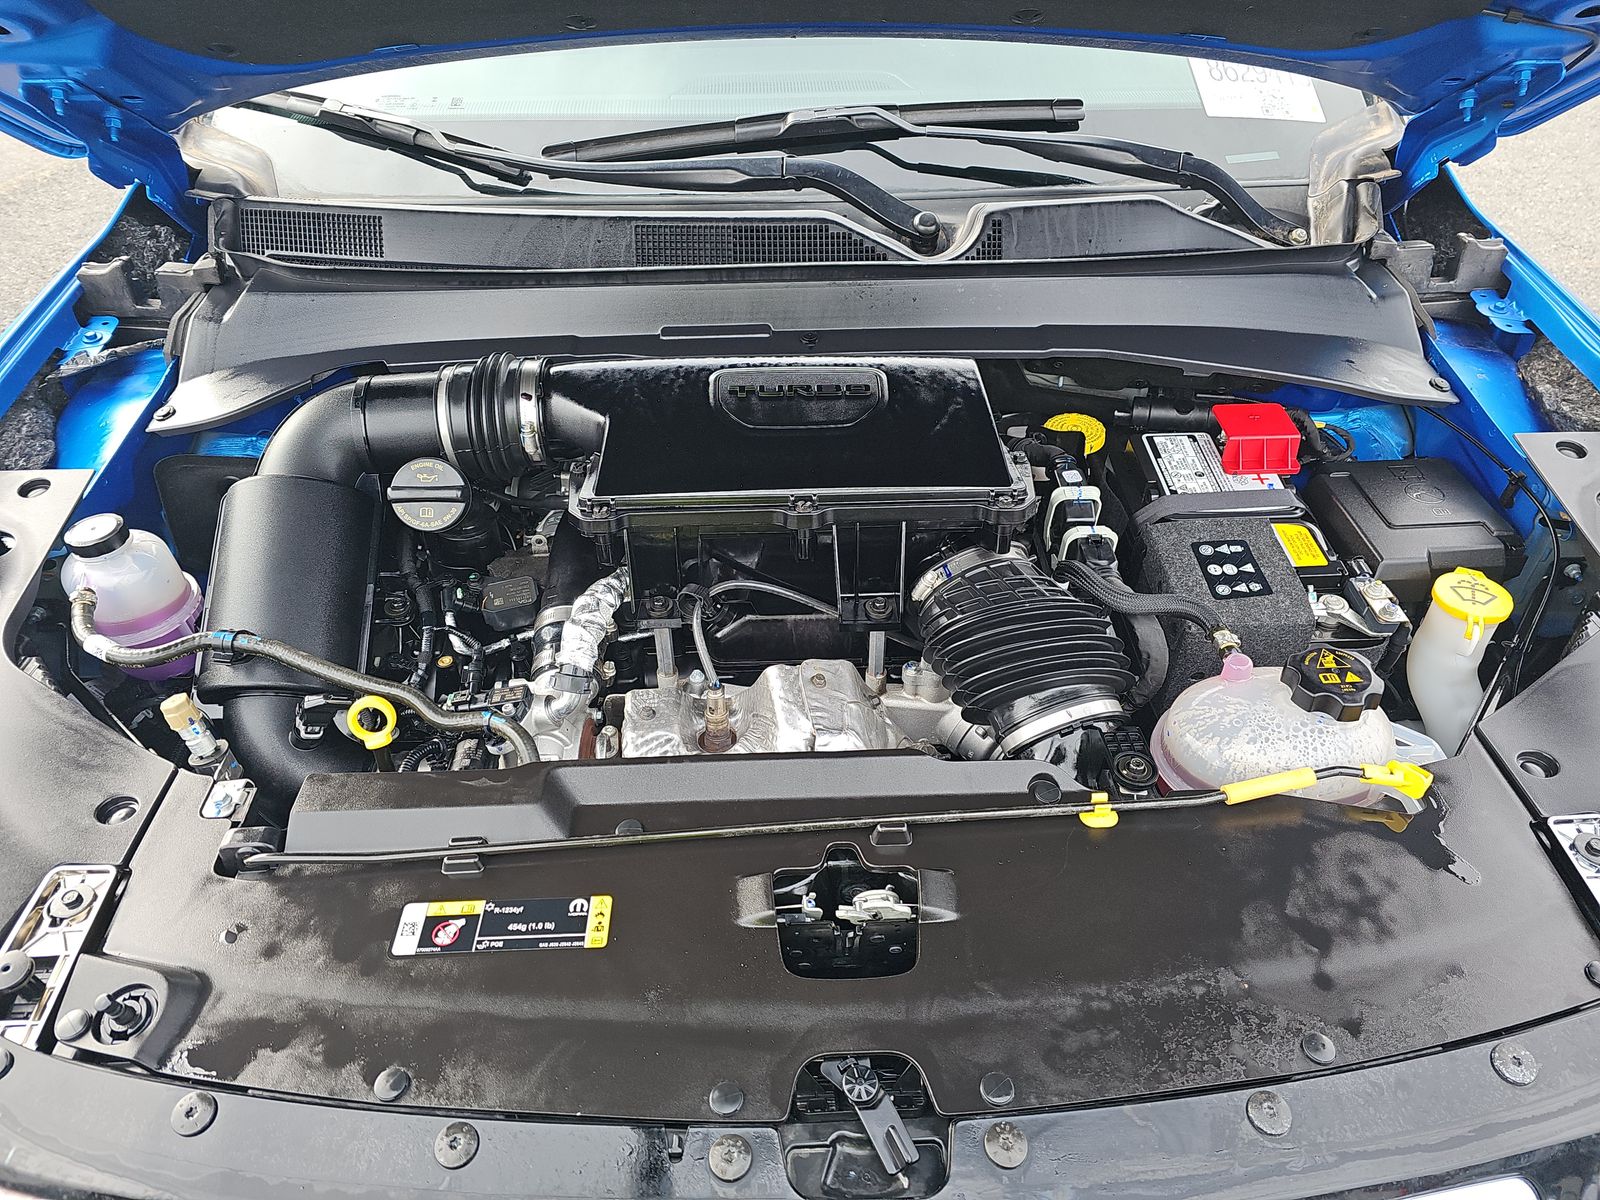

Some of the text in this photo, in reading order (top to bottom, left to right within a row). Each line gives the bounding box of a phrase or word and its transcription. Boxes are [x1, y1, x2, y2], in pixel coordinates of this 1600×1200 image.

[728, 384, 872, 398] TURBO
[410, 462, 444, 472] ENGINE OIL
[396, 505, 406, 516] API
[493, 905, 524, 915] R-1234yf
[507, 921, 555, 932] 454g (1.0 lb)
